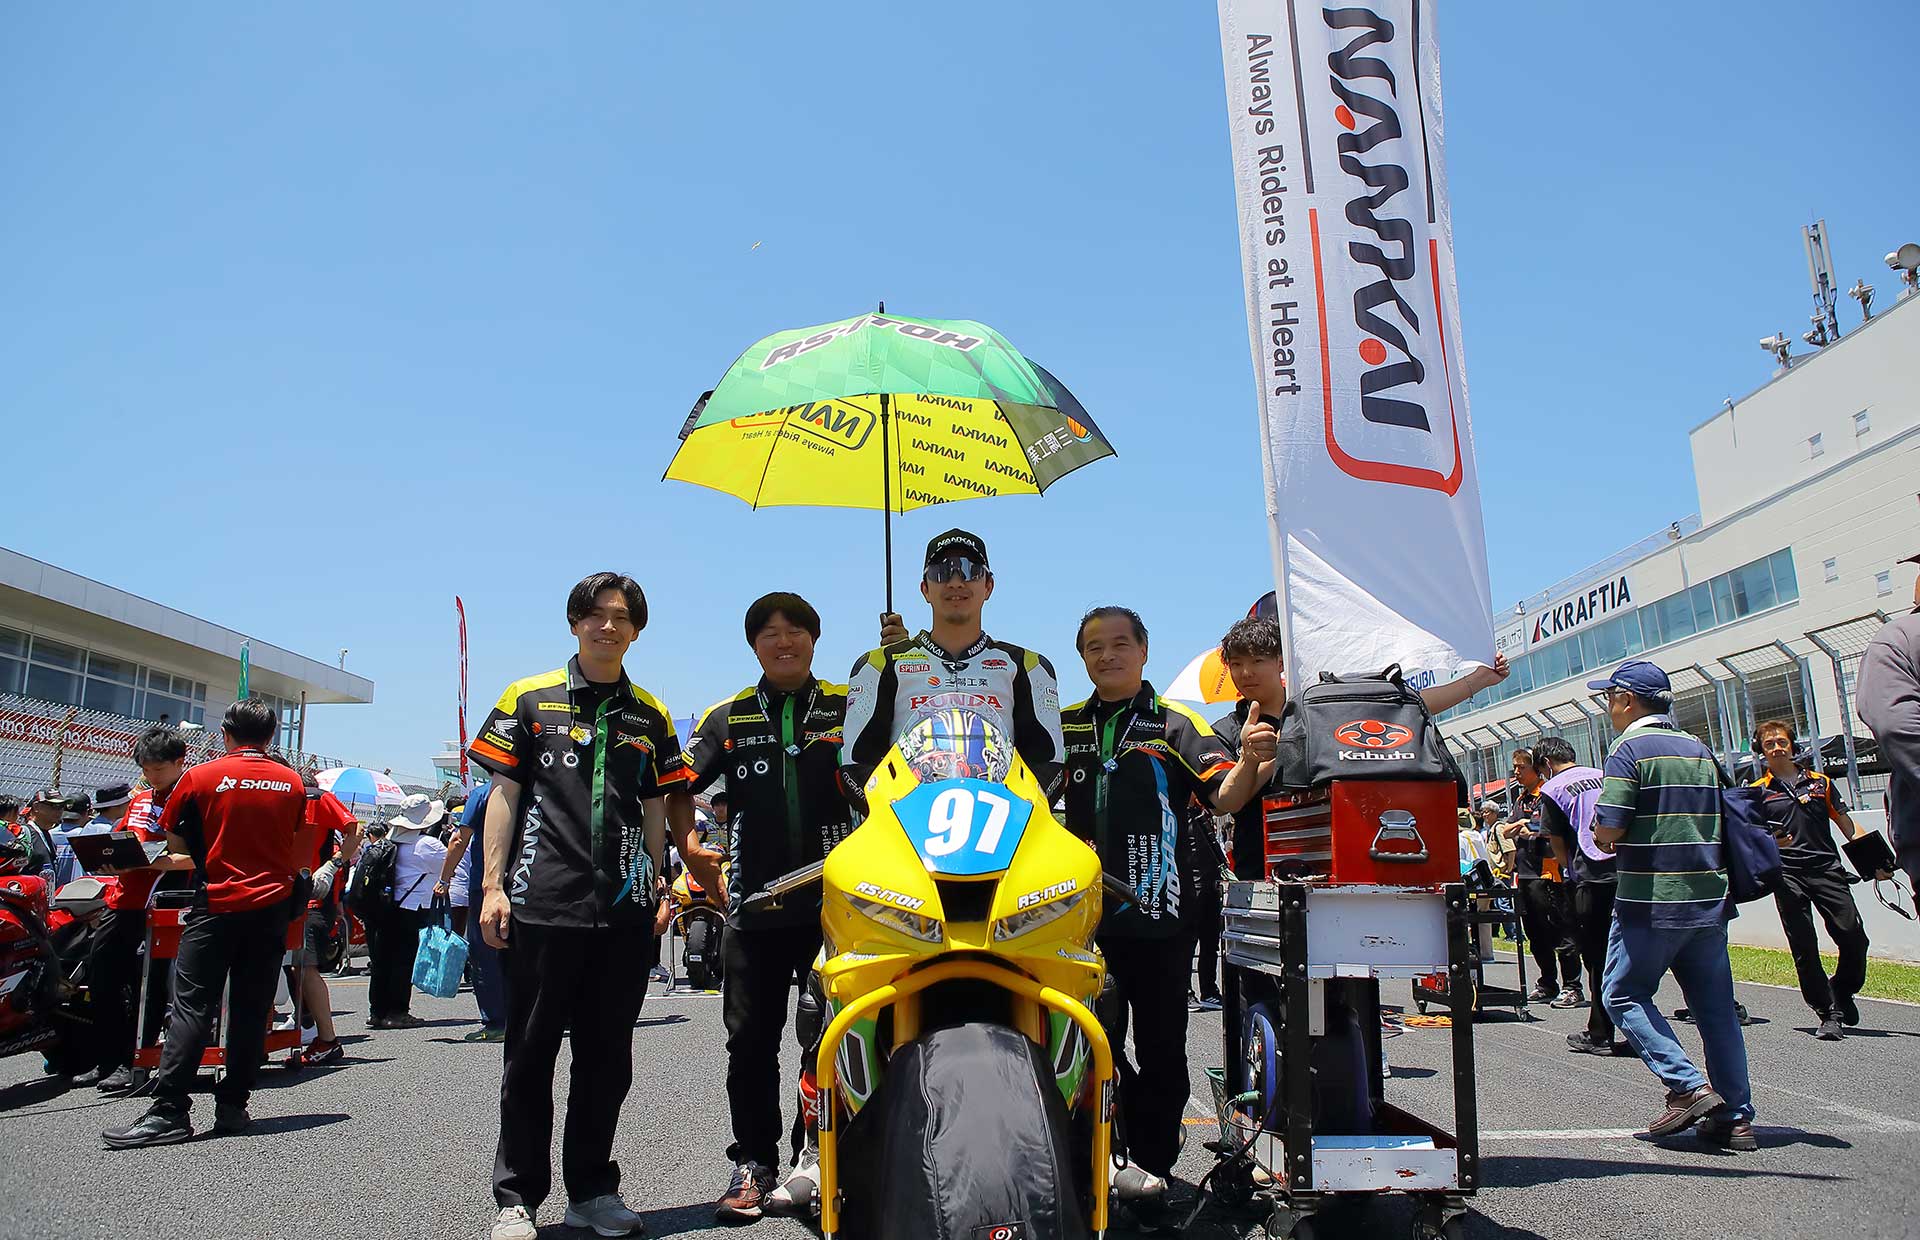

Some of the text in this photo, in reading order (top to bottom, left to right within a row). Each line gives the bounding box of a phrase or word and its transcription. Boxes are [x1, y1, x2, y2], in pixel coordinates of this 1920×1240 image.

[1246, 33, 1301, 396] Always Riders at Heart
[1322, 7, 1431, 434] NANKAI
[1552, 576, 1631, 634] KRAFTIA
[910, 693, 1003, 710] HONDA
[1136, 720, 1165, 728] NANKAI
[1338, 750, 1415, 761] Kabuto
[240, 779, 292, 792] SHOWA
[924, 788, 1010, 856] 97
[619, 826, 629, 879] rs-itoh.com
